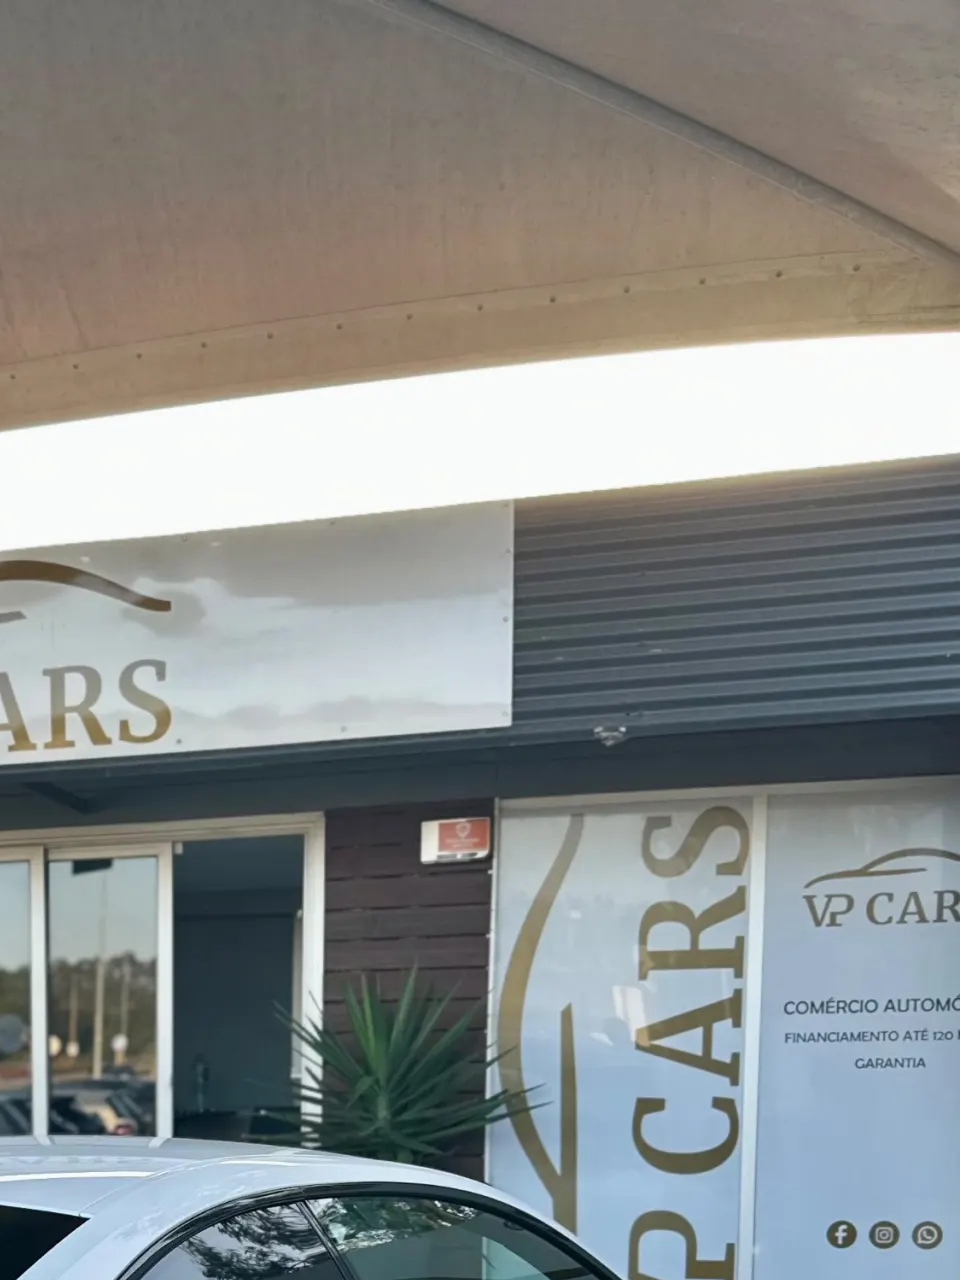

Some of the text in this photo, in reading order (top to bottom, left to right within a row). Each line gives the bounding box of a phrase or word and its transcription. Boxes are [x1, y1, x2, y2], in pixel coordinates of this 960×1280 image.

[802, 889, 960, 927] VP CAR
[631, 805, 751, 1175] CARS
[783, 997, 879, 1016] COMÉRCIO
[784, 1030, 900, 1044] FINANCIAMENTO
[902, 1028, 928, 1041] ATÉ
[932, 1031, 954, 1041] 120
[855, 1057, 926, 1070] GARANTIA
